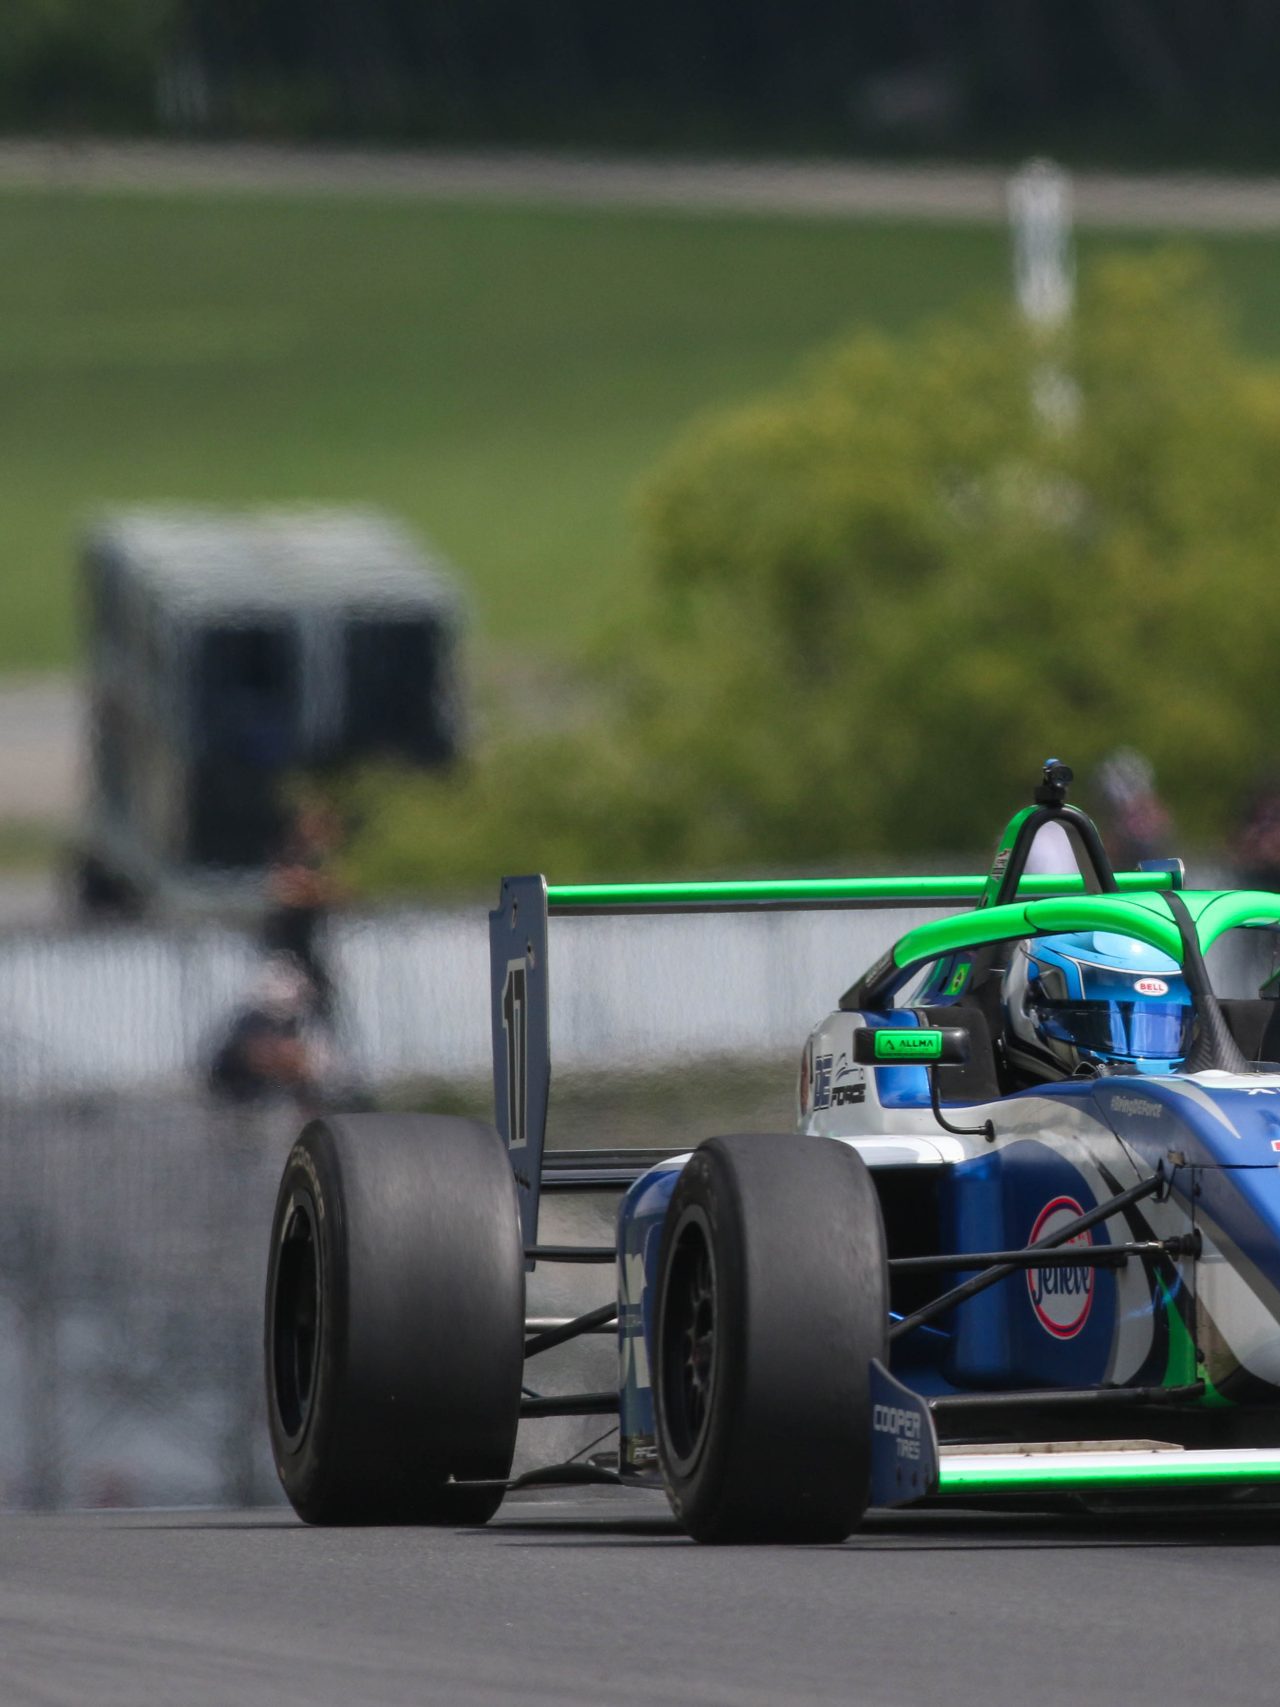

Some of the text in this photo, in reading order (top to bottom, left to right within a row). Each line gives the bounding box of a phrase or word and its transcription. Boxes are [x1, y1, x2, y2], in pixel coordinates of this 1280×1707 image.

[1140, 983, 1164, 991] BELL
[502, 957, 527, 1150] 17
[899, 1039, 934, 1048] ALLMA
[873, 1404, 921, 1439] COOPER
[896, 1437, 920, 1460] TIRES
